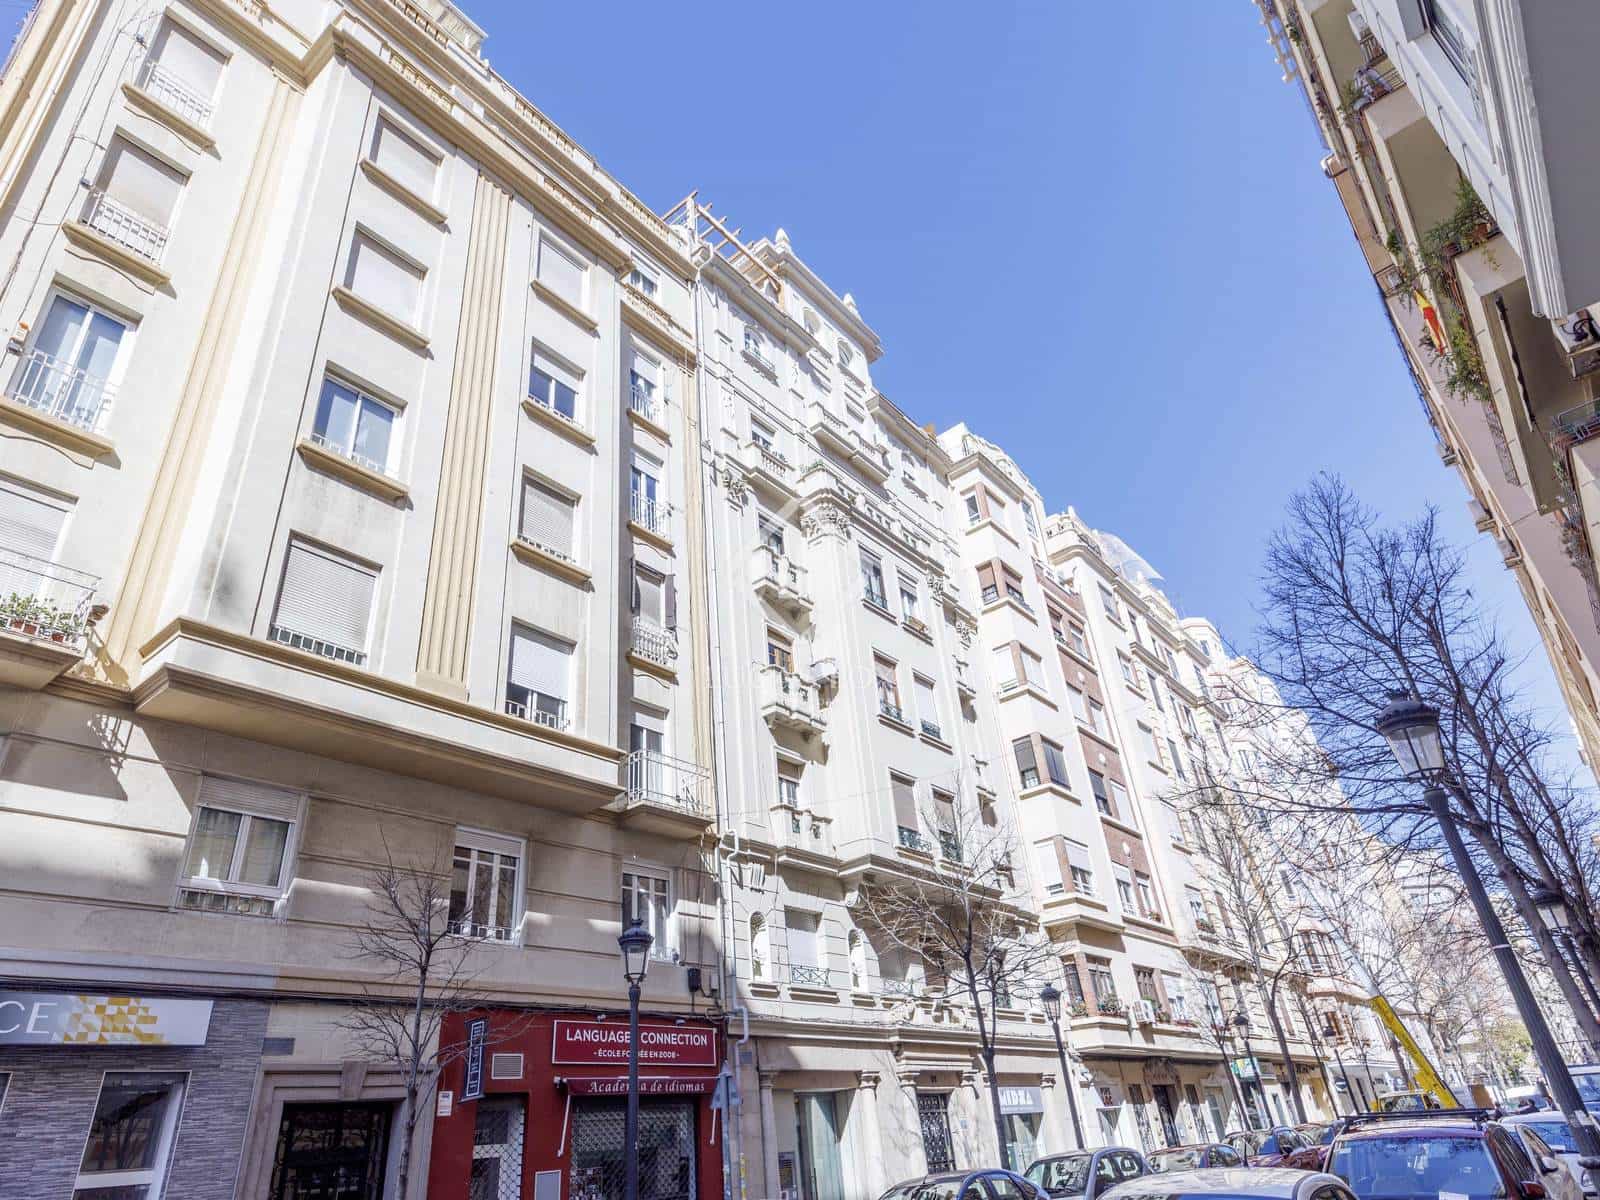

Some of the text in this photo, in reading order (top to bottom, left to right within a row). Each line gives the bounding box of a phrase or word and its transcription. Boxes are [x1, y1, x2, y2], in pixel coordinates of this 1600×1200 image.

[566, 1028, 707, 1046] LANGUAGE CONNECTION
[598, 1048, 621, 1057] ÉCOLE
[588, 1079, 705, 1093] Acadea de idiomas
